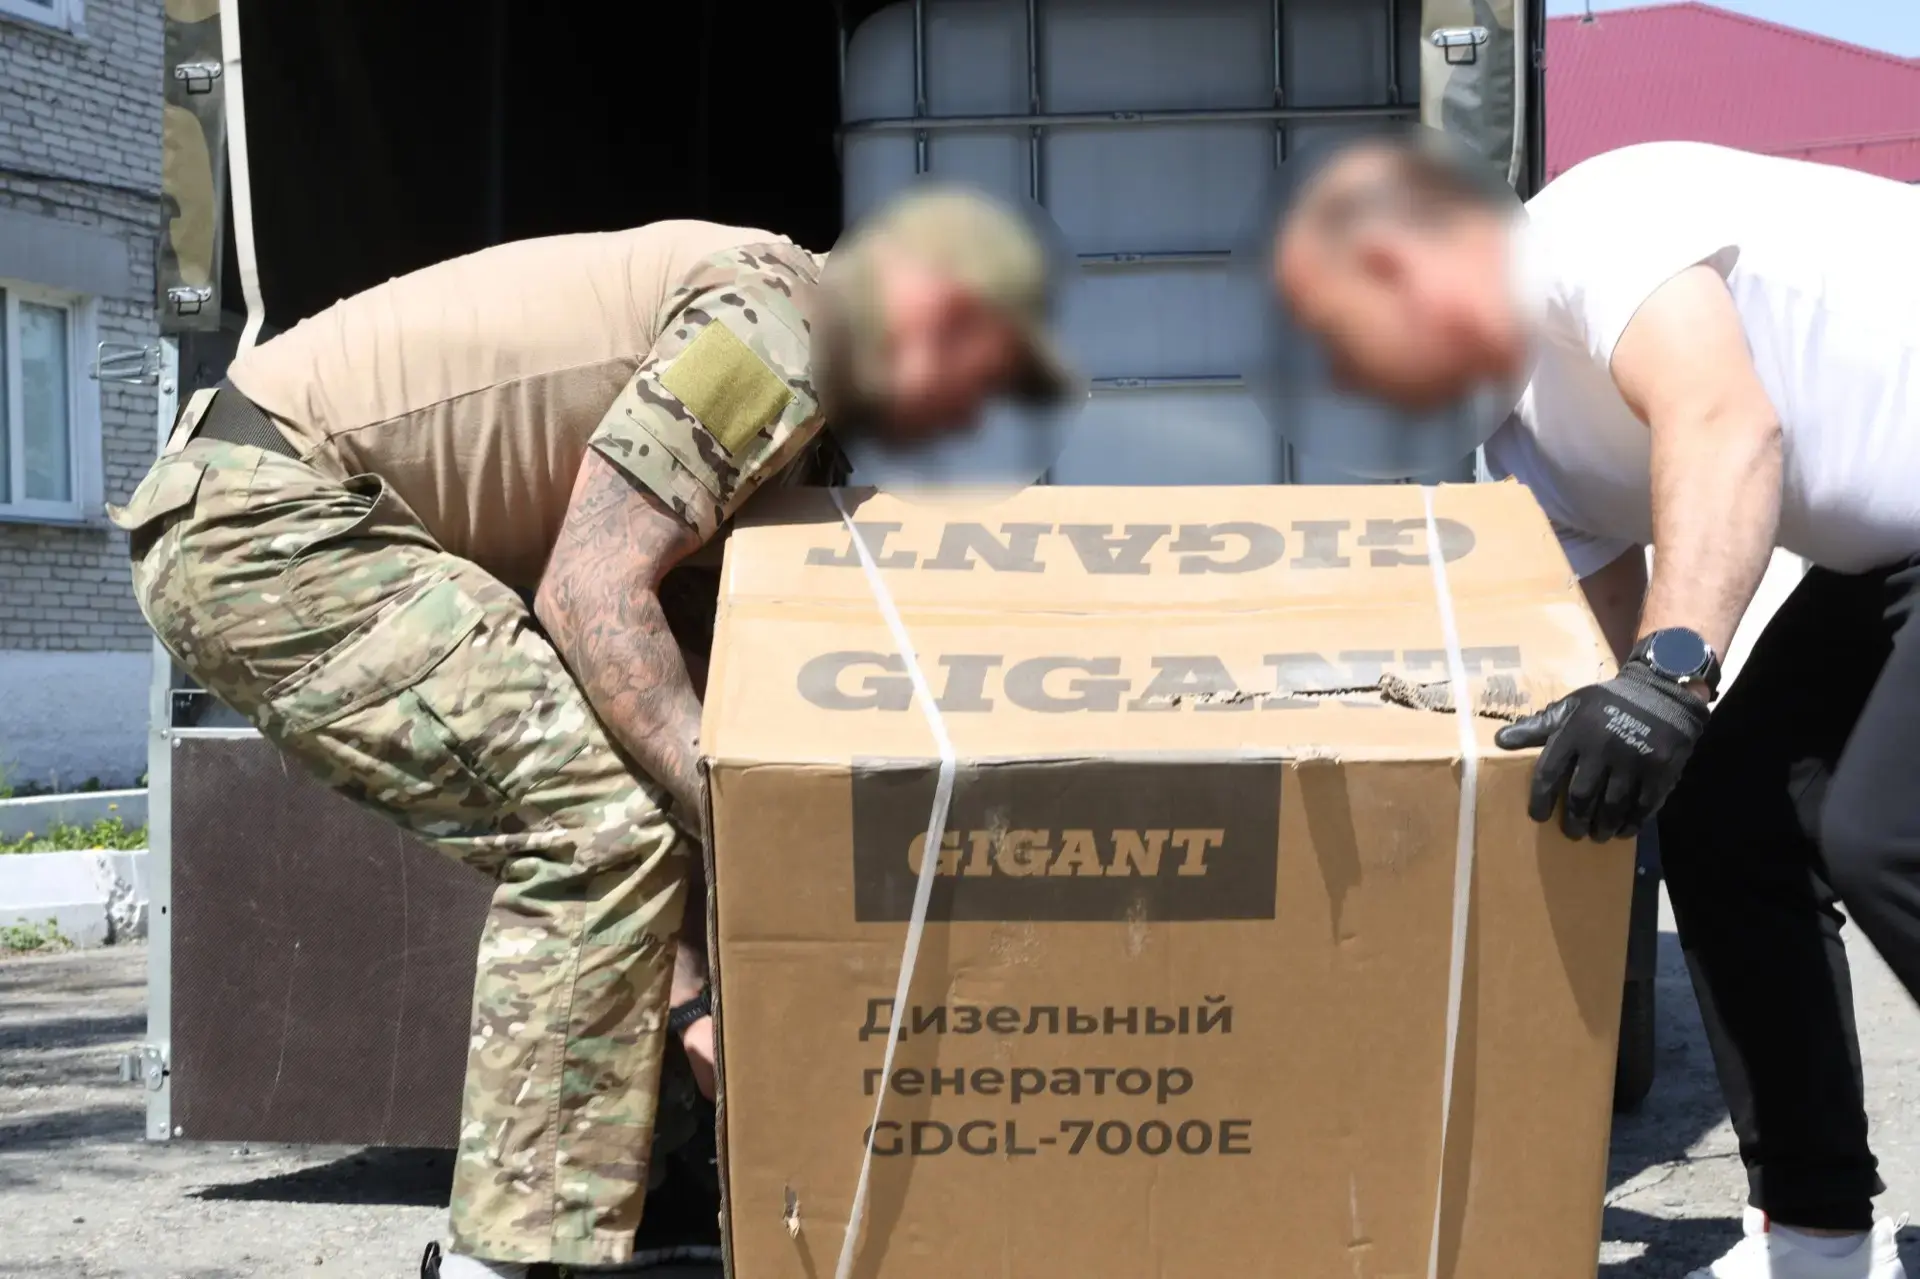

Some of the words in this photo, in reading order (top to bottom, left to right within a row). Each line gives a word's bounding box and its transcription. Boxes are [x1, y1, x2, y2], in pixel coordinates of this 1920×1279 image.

[804, 517, 1476, 575] GIGANT
[908, 829, 1225, 877] GIGANT
[858, 995, 1234, 1042] Дизельный
[862, 1066, 1194, 1103] генератор
[862, 1119, 1252, 1156] GDGL-7000E
